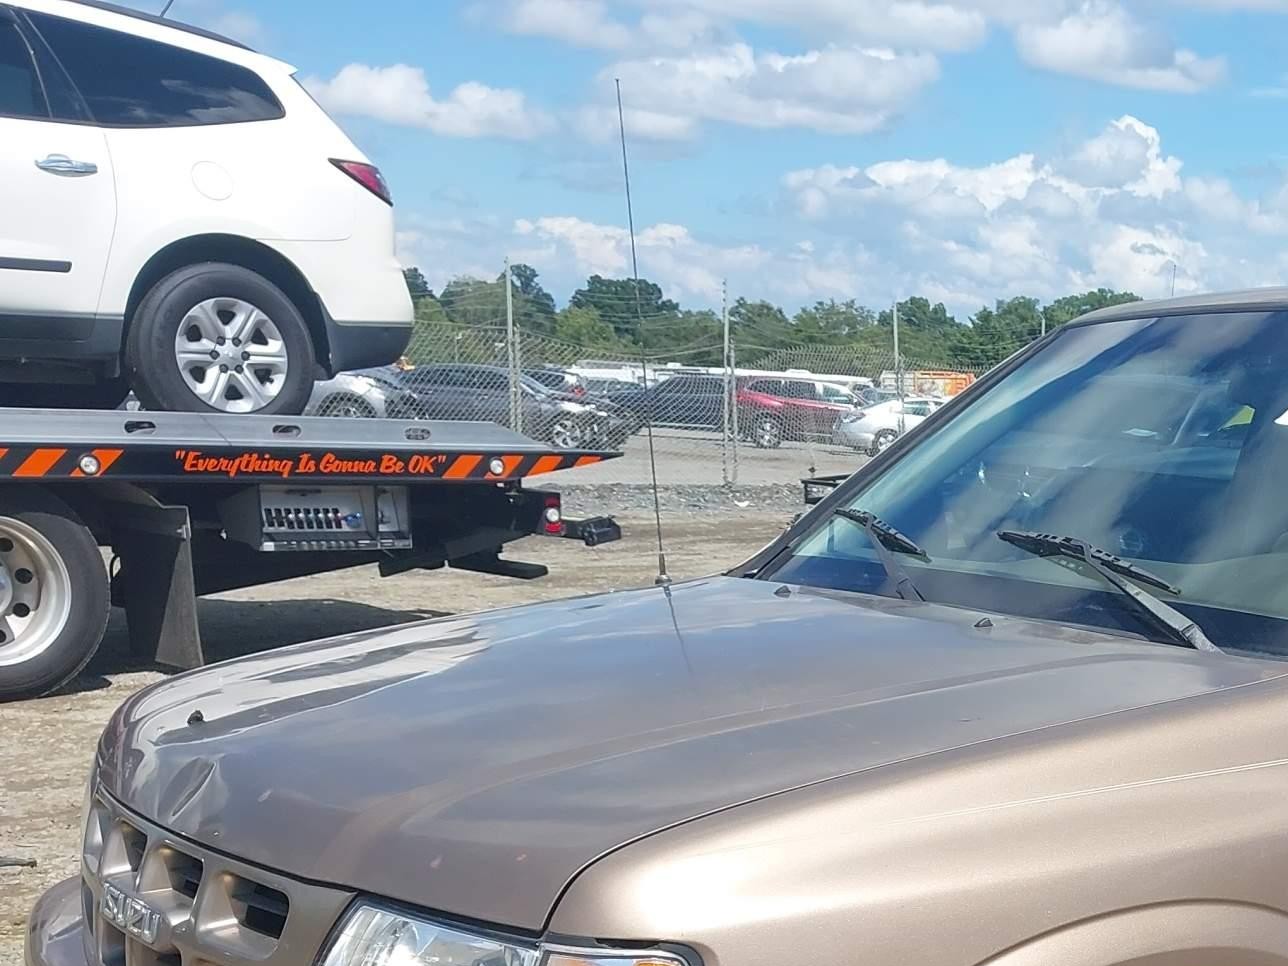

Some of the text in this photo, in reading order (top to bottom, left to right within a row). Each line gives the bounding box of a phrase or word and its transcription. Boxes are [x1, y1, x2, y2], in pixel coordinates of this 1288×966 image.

[174, 449, 447, 478] "Everything Is Gonna Be OK"
